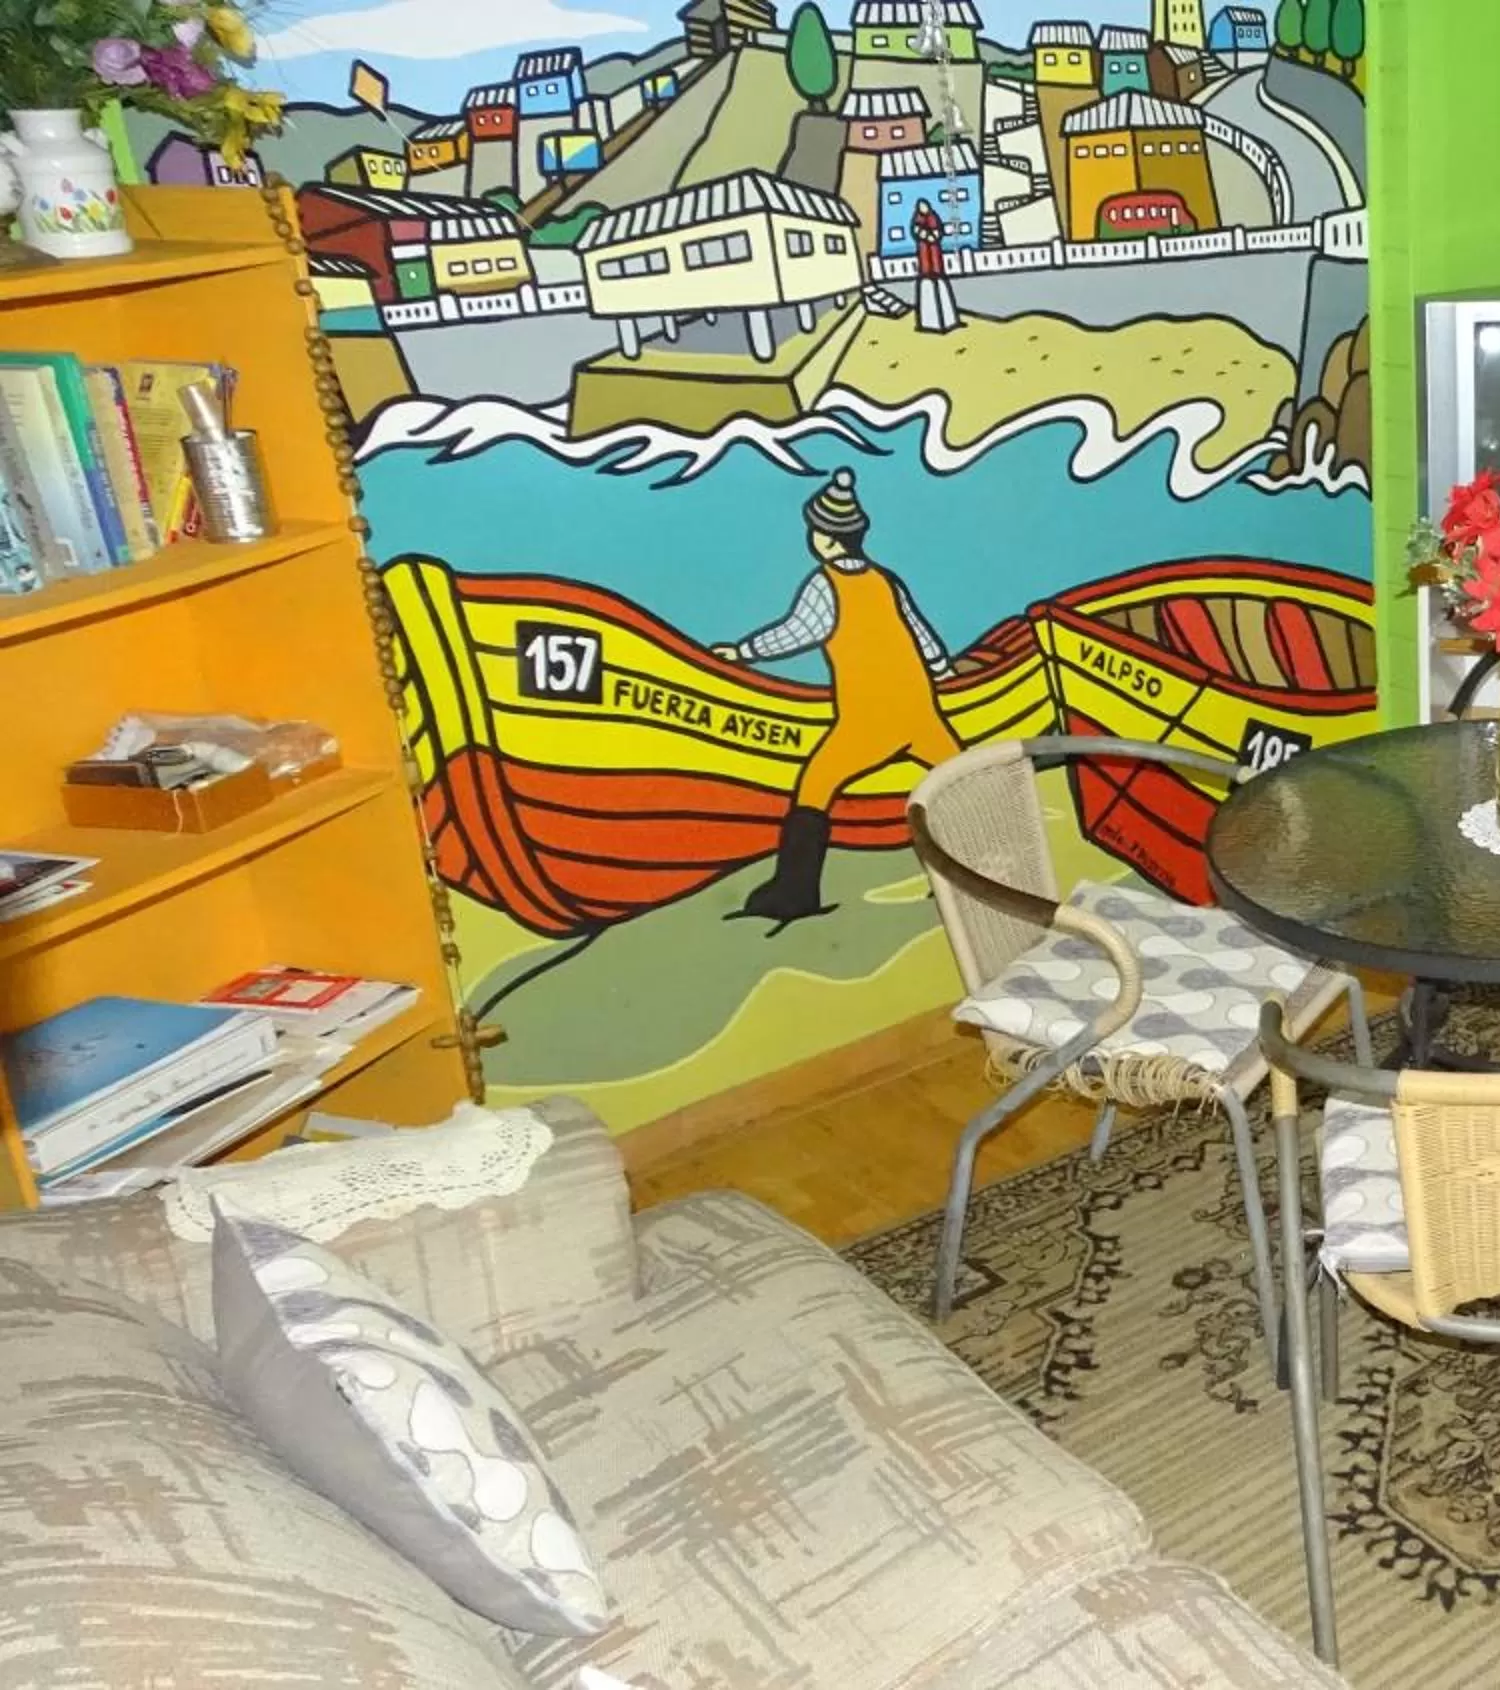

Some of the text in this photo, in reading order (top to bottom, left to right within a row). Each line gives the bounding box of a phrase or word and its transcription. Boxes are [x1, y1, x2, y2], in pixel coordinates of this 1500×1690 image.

[525, 634, 598, 693] 157
[1079, 640, 1163, 699] VALPSO
[613, 679, 801, 748] FUERZA AYSEN
